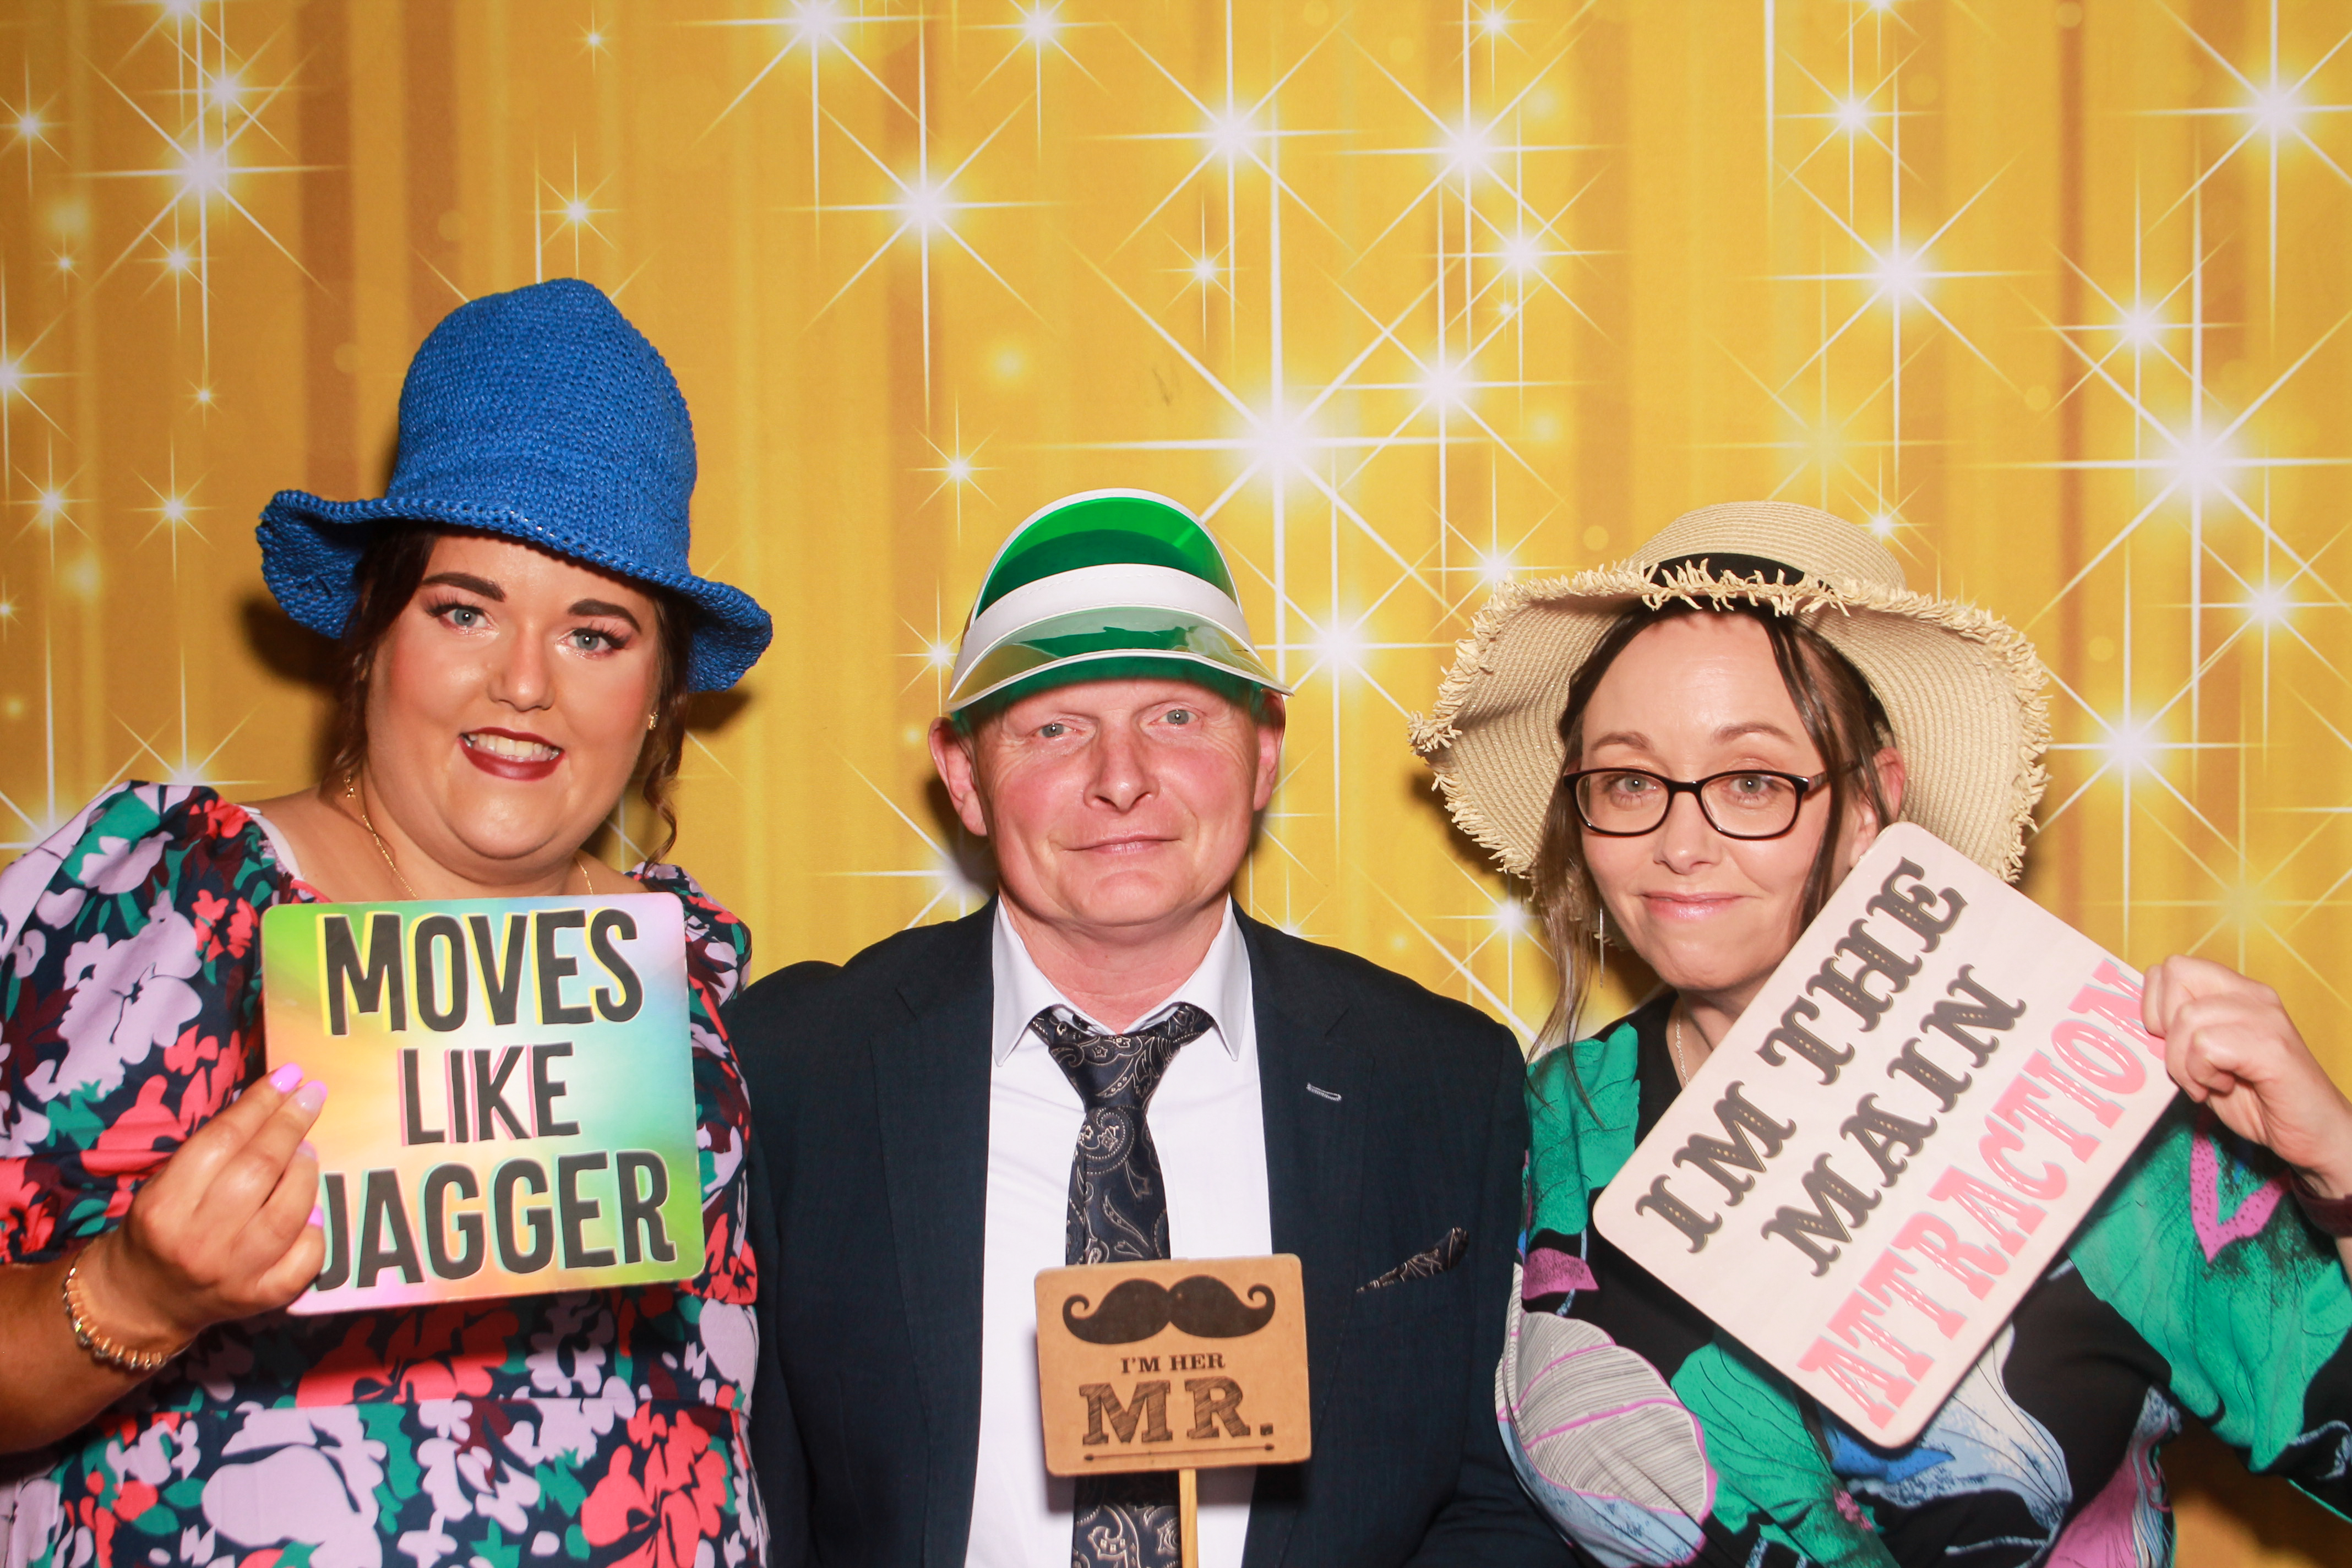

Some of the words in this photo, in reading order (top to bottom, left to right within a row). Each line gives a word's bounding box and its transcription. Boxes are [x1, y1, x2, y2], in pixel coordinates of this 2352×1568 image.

[317, 907, 644, 1036] MOVES
[398, 1042, 580, 1146] LIKE
[1636, 1081, 1796, 1254] IM
[1756, 856, 1969, 1086] THE
[1761, 963, 2027, 1277] MAIN
[314, 1149, 677, 1291] JAGGER
[1796, 959, 2166, 1430] ATTRACTION
[1079, 1376, 1273, 1446] MR.
[1120, 1356, 1161, 1374] I'M
[1169, 1352, 1226, 1371] HER
